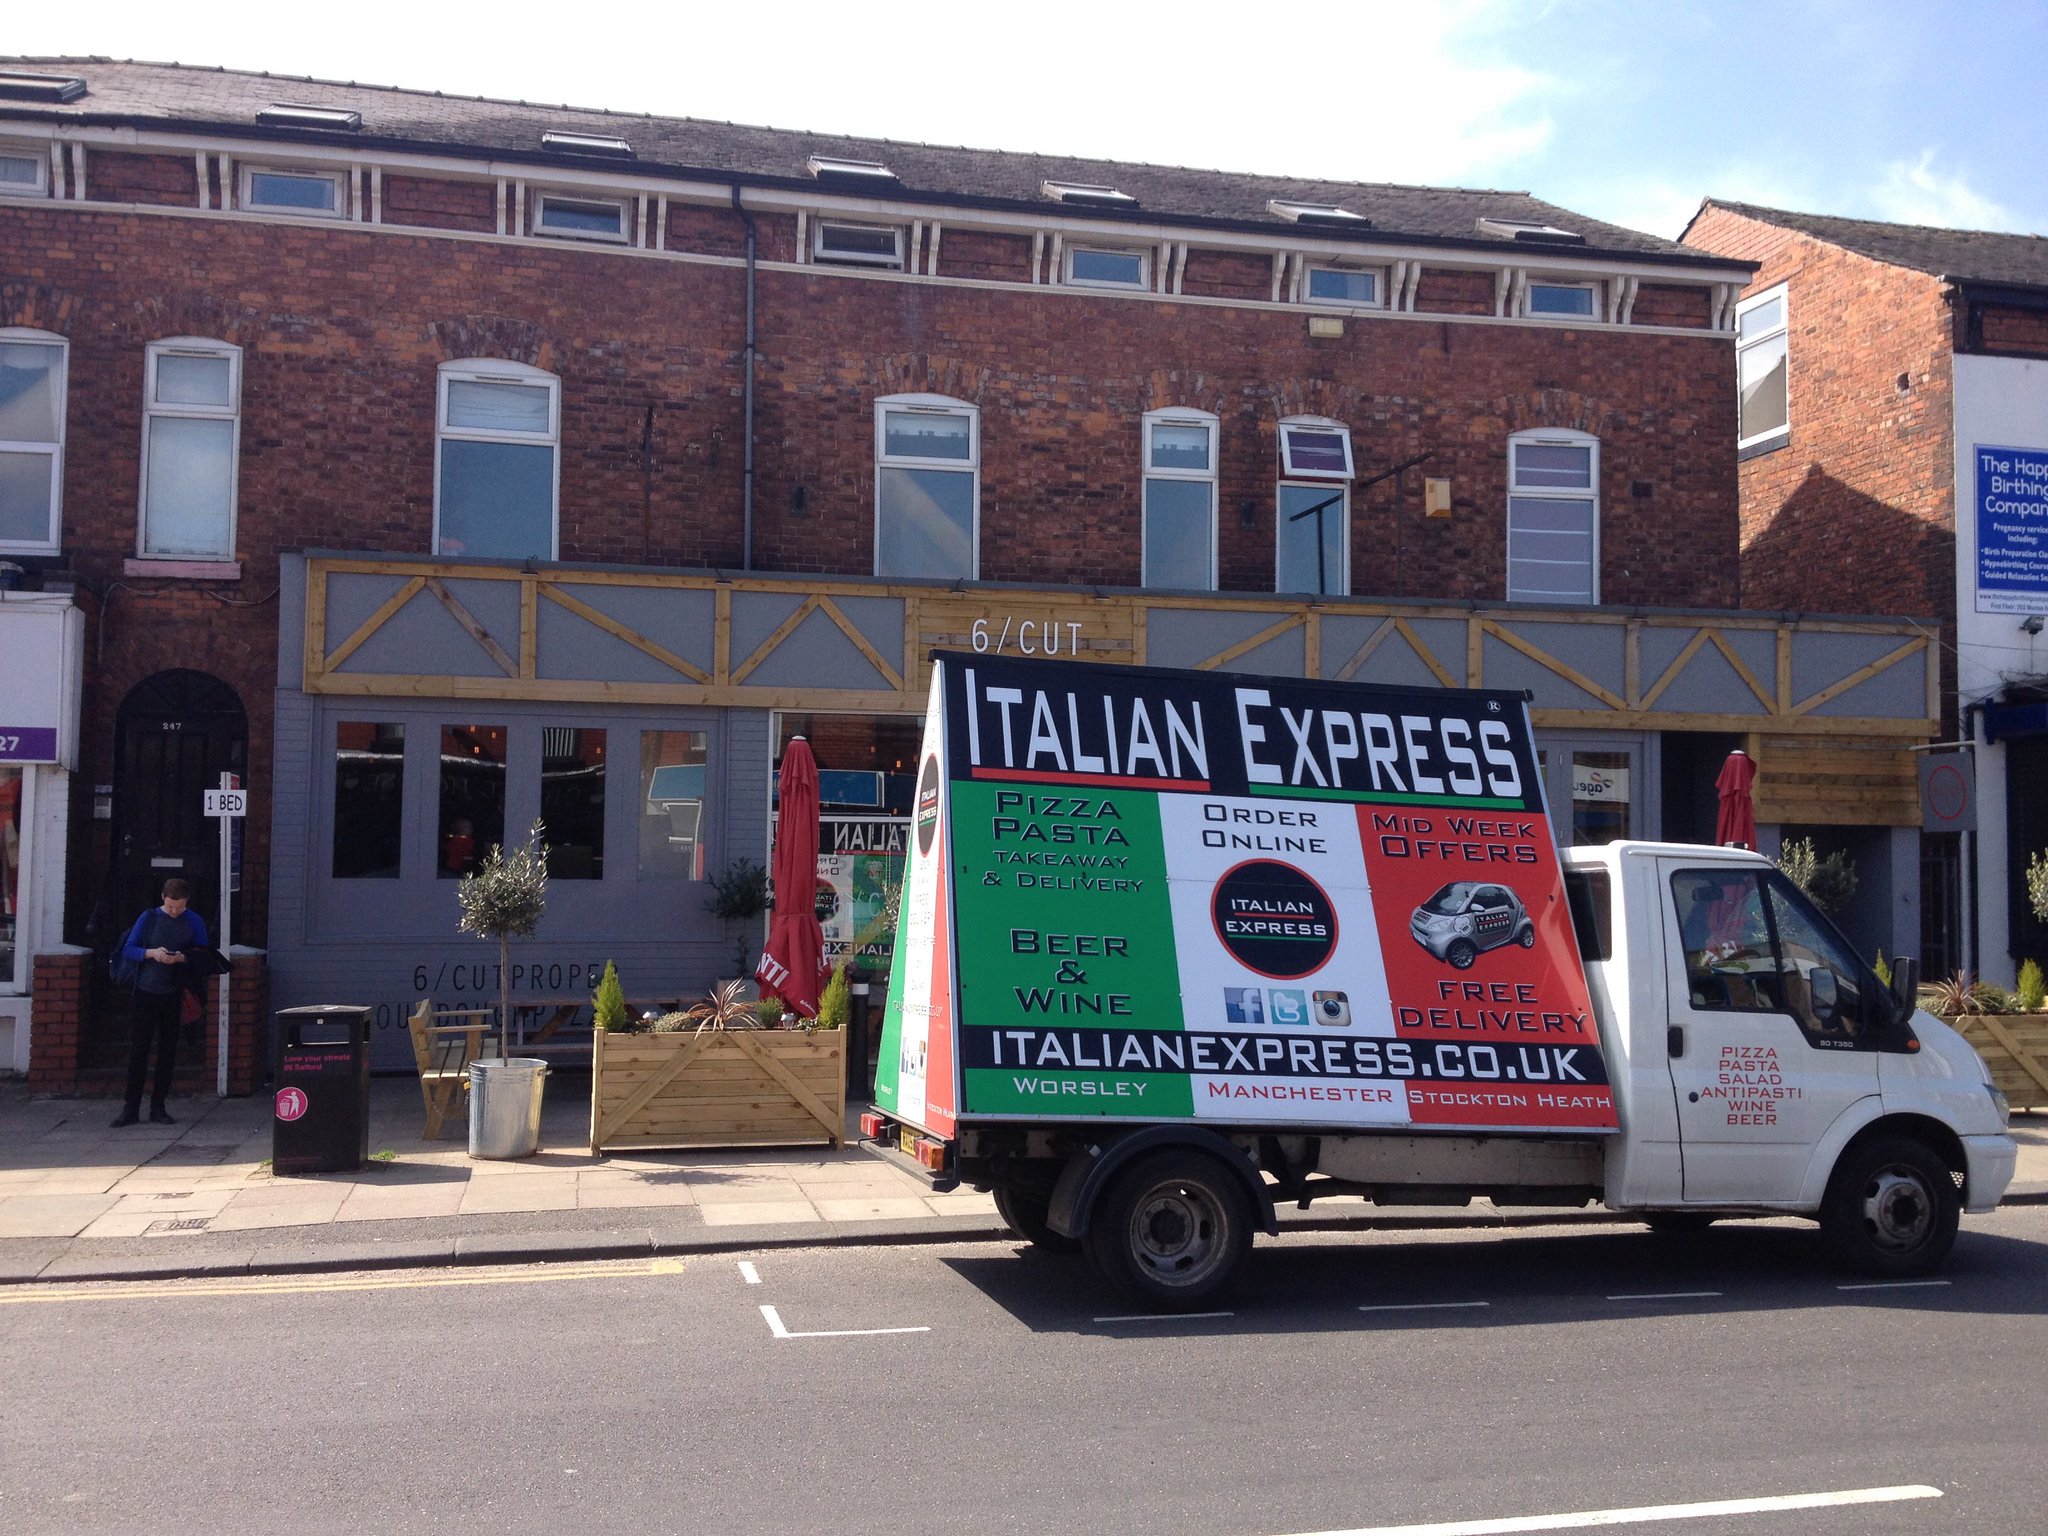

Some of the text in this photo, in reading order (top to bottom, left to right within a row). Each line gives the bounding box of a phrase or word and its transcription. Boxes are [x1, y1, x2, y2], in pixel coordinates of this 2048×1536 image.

[1981, 454, 2010, 473] The
[972, 616, 1082, 656] 6/CUT
[162, 722, 182, 731] 247
[965, 668, 1209, 780] ITALIAN
[1234, 687, 1523, 798] EXPRESS
[207, 794, 243, 811] 1 BED
[995, 789, 1122, 820] PIZZA
[1203, 803, 1319, 828] ORDER
[1371, 812, 1537, 838] MID WEEK
[992, 816, 1131, 847] PASTA
[1202, 829, 1328, 854] ONLINE
[992, 850, 1129, 870] TAKEAWAY
[1379, 834, 1539, 864] OFFERS
[982, 870, 1144, 893] & DELIVERY
[1231, 898, 1314, 914] ITALIAN
[1225, 920, 1327, 936] EXPRESS
[1010, 928, 1129, 957] BEER
[1055, 959, 1088, 985] &
[1013, 986, 1133, 1016] WINE
[1437, 980, 1538, 1004] FREE
[1397, 1006, 1587, 1034] DELIVERY
[992, 1030, 1587, 1081] ITALIANEXPRESS.CO.UK
[1721, 1046, 1778, 1059] PIZZA
[1719, 1060, 1780, 1072] PASTA
[1719, 1073, 1782, 1085] SALAD
[1013, 1077, 1611, 1109] WORSLEY MANCHESTER STOCKTON HEATH
[1701, 1086, 1802, 1099] ANTIPASTI
[1728, 1100, 1776, 1112] WINE
[1727, 1113, 1777, 1125] BEER
